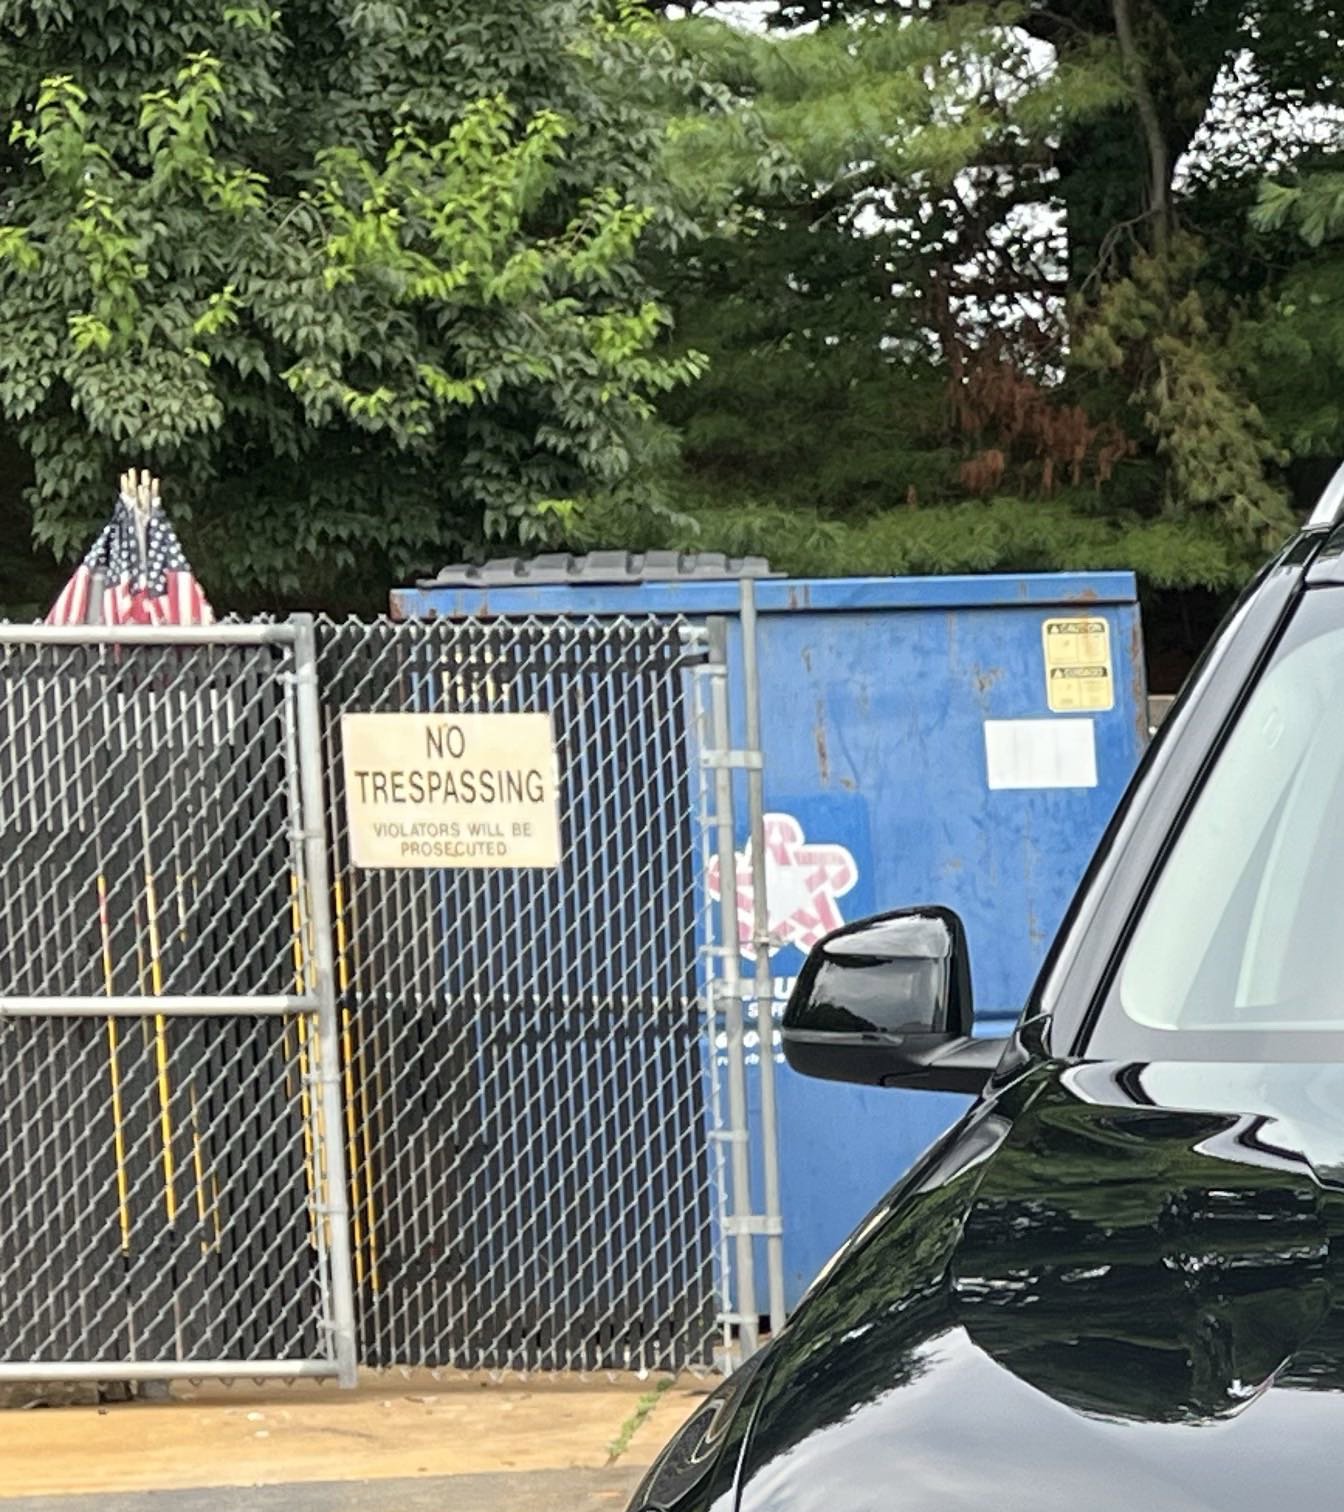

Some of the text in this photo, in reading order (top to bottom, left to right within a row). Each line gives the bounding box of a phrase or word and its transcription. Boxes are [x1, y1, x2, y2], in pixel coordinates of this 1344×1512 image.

[425, 724, 466, 758] NO
[354, 769, 545, 804] TRESPASSING
[373, 822, 532, 838] VIOLATORS WILL BE
[401, 841, 508, 856] PROSECUTED
